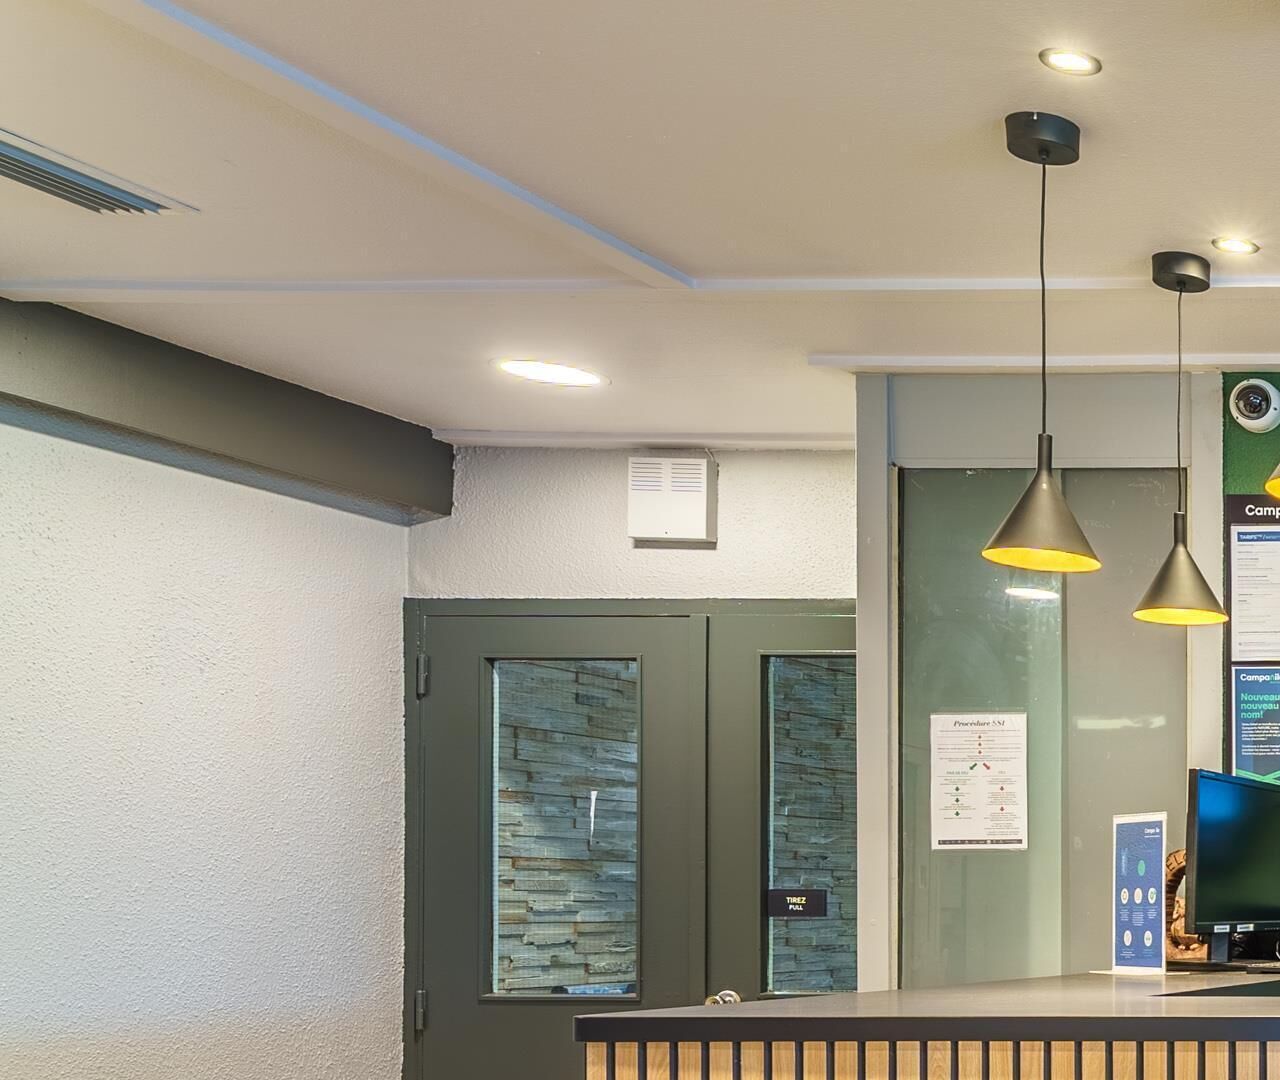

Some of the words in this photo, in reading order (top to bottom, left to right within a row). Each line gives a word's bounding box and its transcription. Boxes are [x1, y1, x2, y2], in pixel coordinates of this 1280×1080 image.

[1240, 693, 1280, 701] Nouveau
[1240, 711, 1264, 719] nom!
[785, 896, 807, 904] TIREZ
